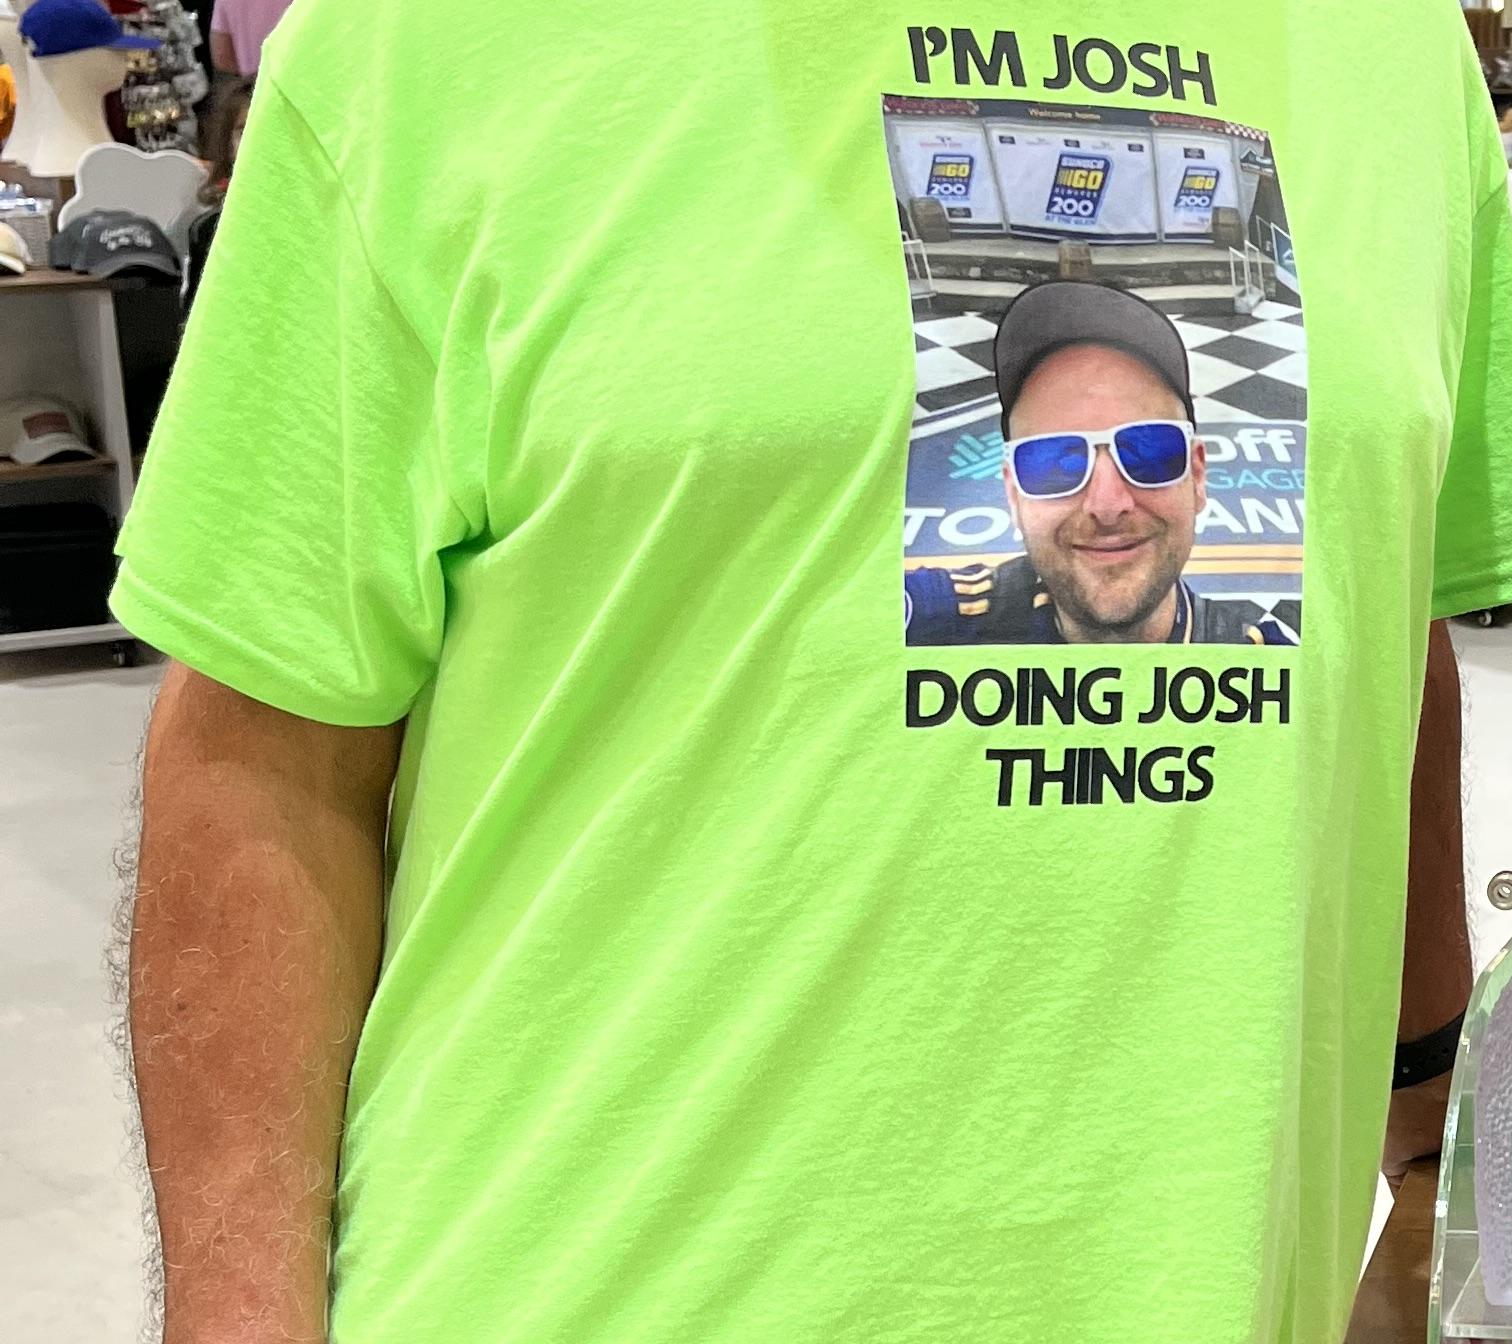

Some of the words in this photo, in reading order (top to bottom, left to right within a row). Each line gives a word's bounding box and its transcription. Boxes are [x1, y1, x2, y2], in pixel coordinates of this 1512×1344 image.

[907, 26, 1027, 87] I'M
[1043, 34, 1217, 106] JOSH
[930, 183, 966, 195] 200
[1050, 196, 1094, 216] 200
[1178, 195, 1210, 207] 200
[1194, 497, 1304, 534] AN
[906, 667, 1123, 727] DOING
[1137, 667, 1290, 724] JOSH
[985, 745, 1215, 807] THINGS
